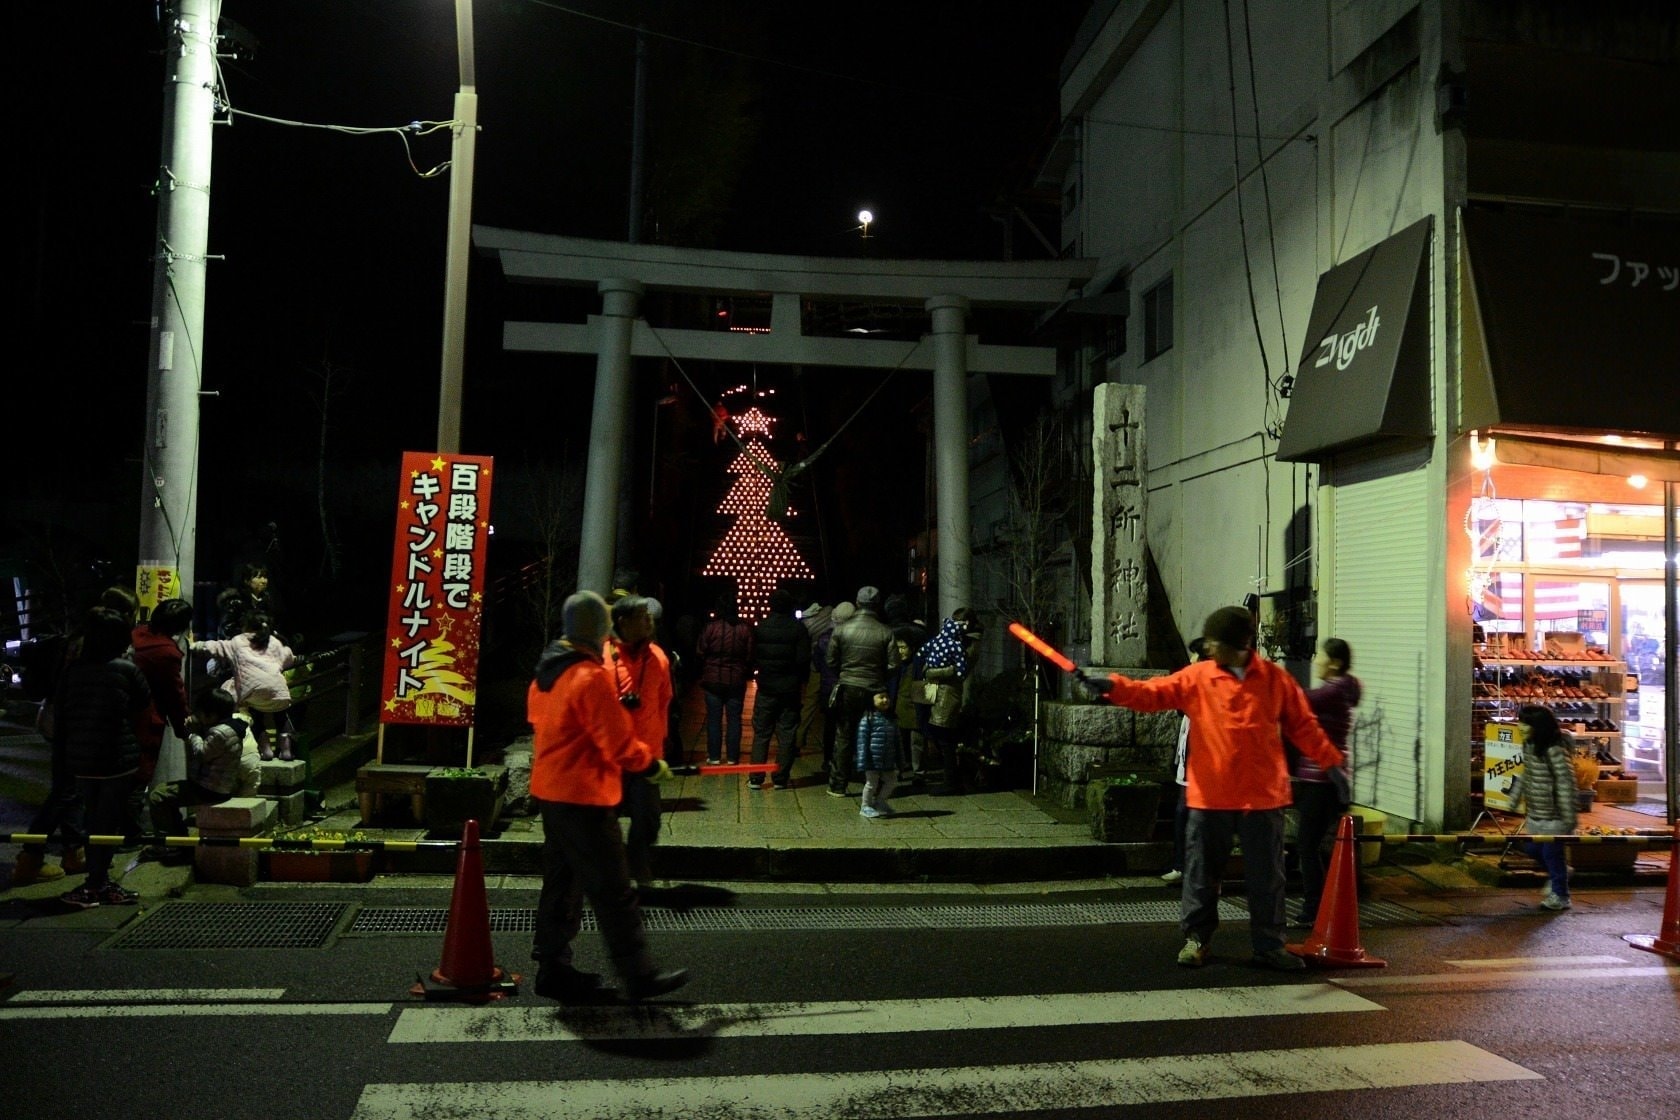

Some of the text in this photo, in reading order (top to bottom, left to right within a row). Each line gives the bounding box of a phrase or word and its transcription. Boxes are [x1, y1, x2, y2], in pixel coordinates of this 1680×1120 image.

[1591, 252, 1680, 291] ファッ
[397, 473, 441, 697] キャンドルナイト
[442, 463, 479, 609] 百段階段で
[1109, 409, 1141, 644] 十二所神社
